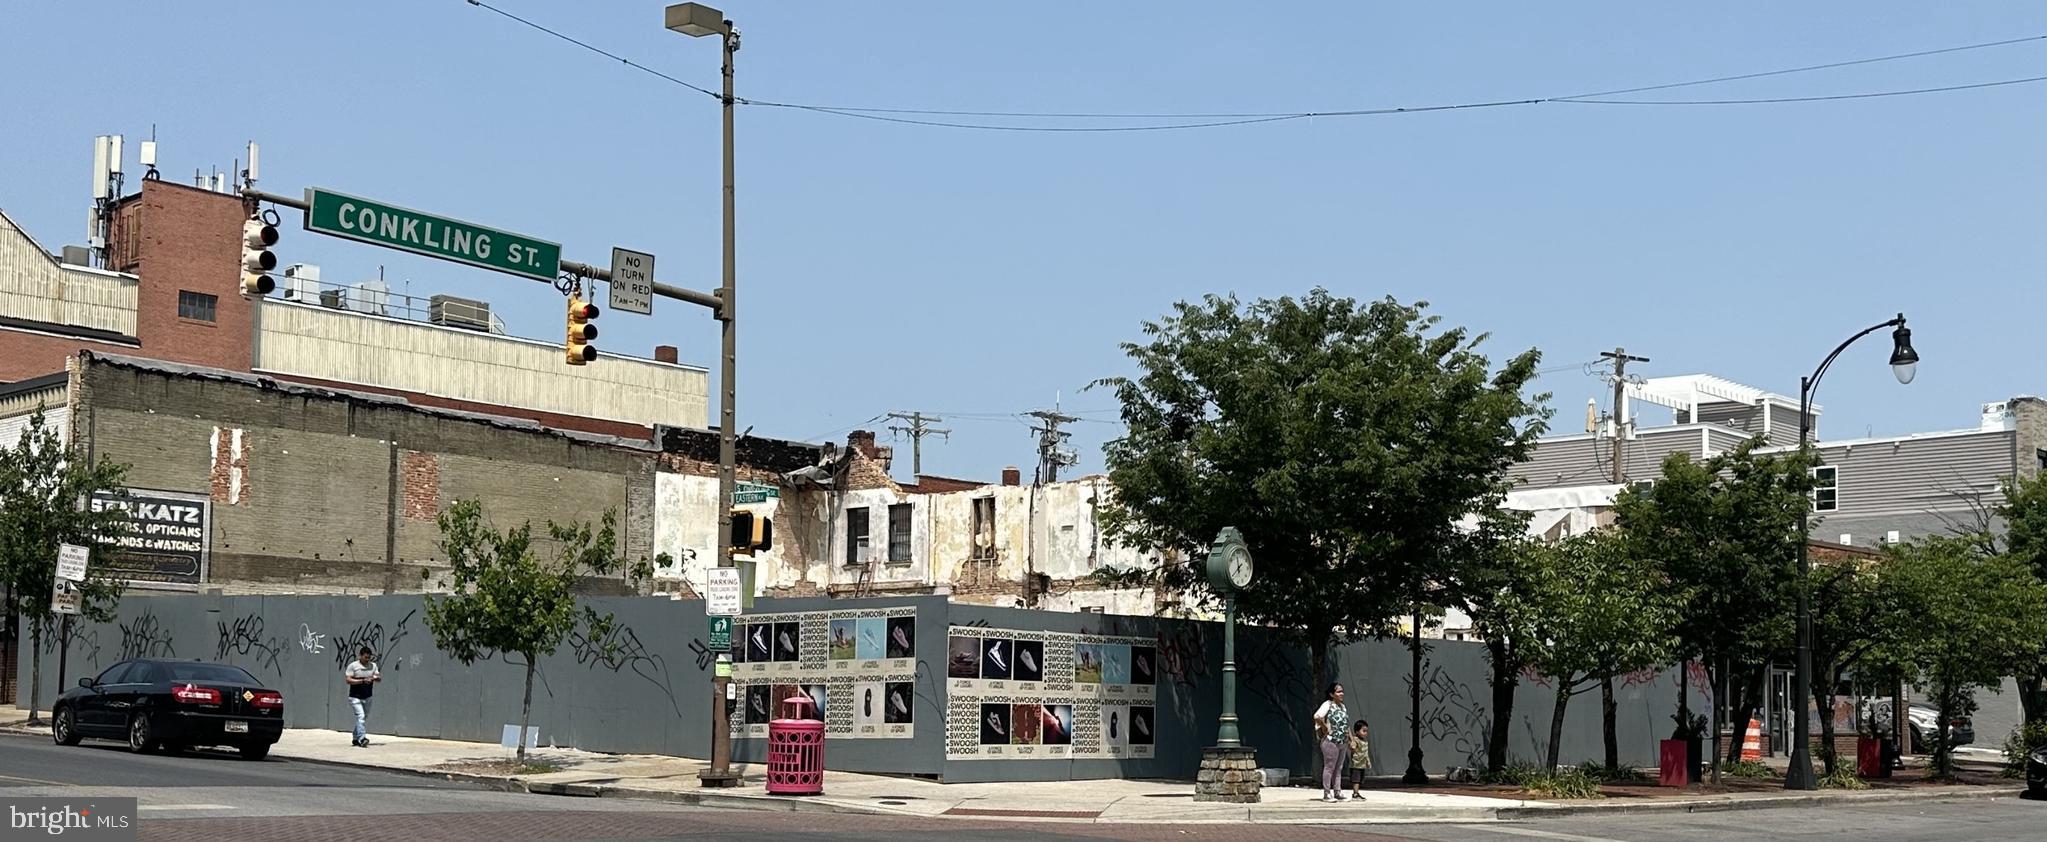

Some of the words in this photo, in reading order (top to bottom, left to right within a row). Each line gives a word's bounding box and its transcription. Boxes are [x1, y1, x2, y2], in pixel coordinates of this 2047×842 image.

[338, 203, 491, 259] CONKLING
[507, 243, 540, 268] ST.
[626, 257, 640, 268] NO
[621, 268, 645, 282] TURN
[612, 280, 626, 291] ON
[631, 283, 650, 295] RED
[138, 502, 200, 523] KATZ
[146, 523, 202, 538] OPTICIANS
